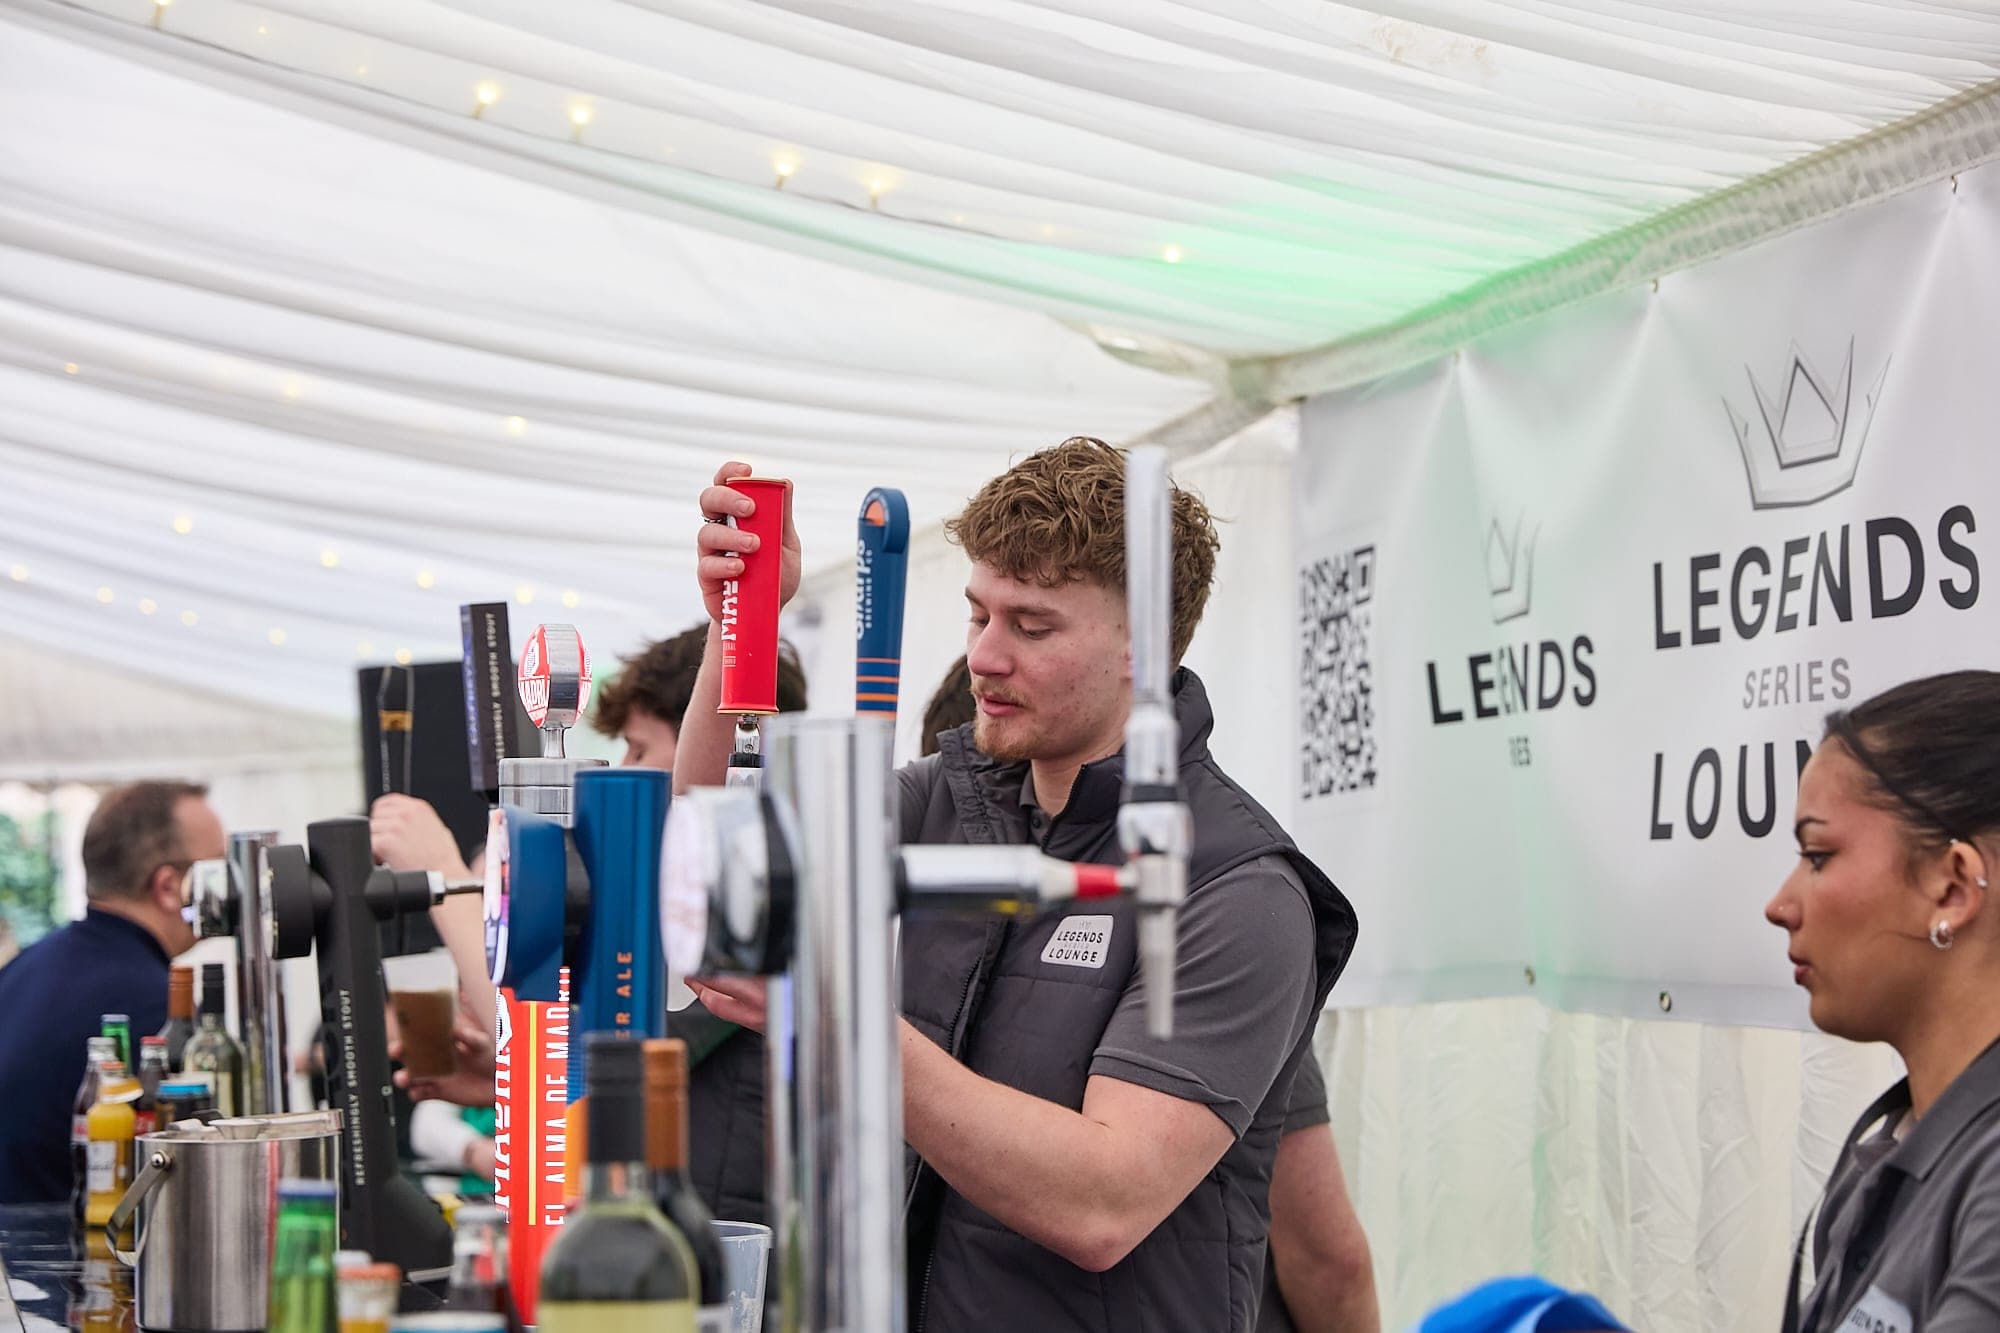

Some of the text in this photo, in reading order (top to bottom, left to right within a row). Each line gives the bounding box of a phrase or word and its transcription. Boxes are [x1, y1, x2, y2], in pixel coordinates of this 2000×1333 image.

[1653, 504, 1980, 651] LEGENDS
[484, 612, 498, 647] STOUT
[488, 651, 502, 698] SMOOTH
[1743, 657, 1852, 709] SERIES
[1649, 739, 1813, 841] LOU
[1048, 947, 1098, 963] LOUNGE
[1057, 930, 1104, 944] LEGENDS
[615, 951, 633, 997] ALE
[338, 989, 366, 1186] REFRESHINGLY SMOOTH STOUT
